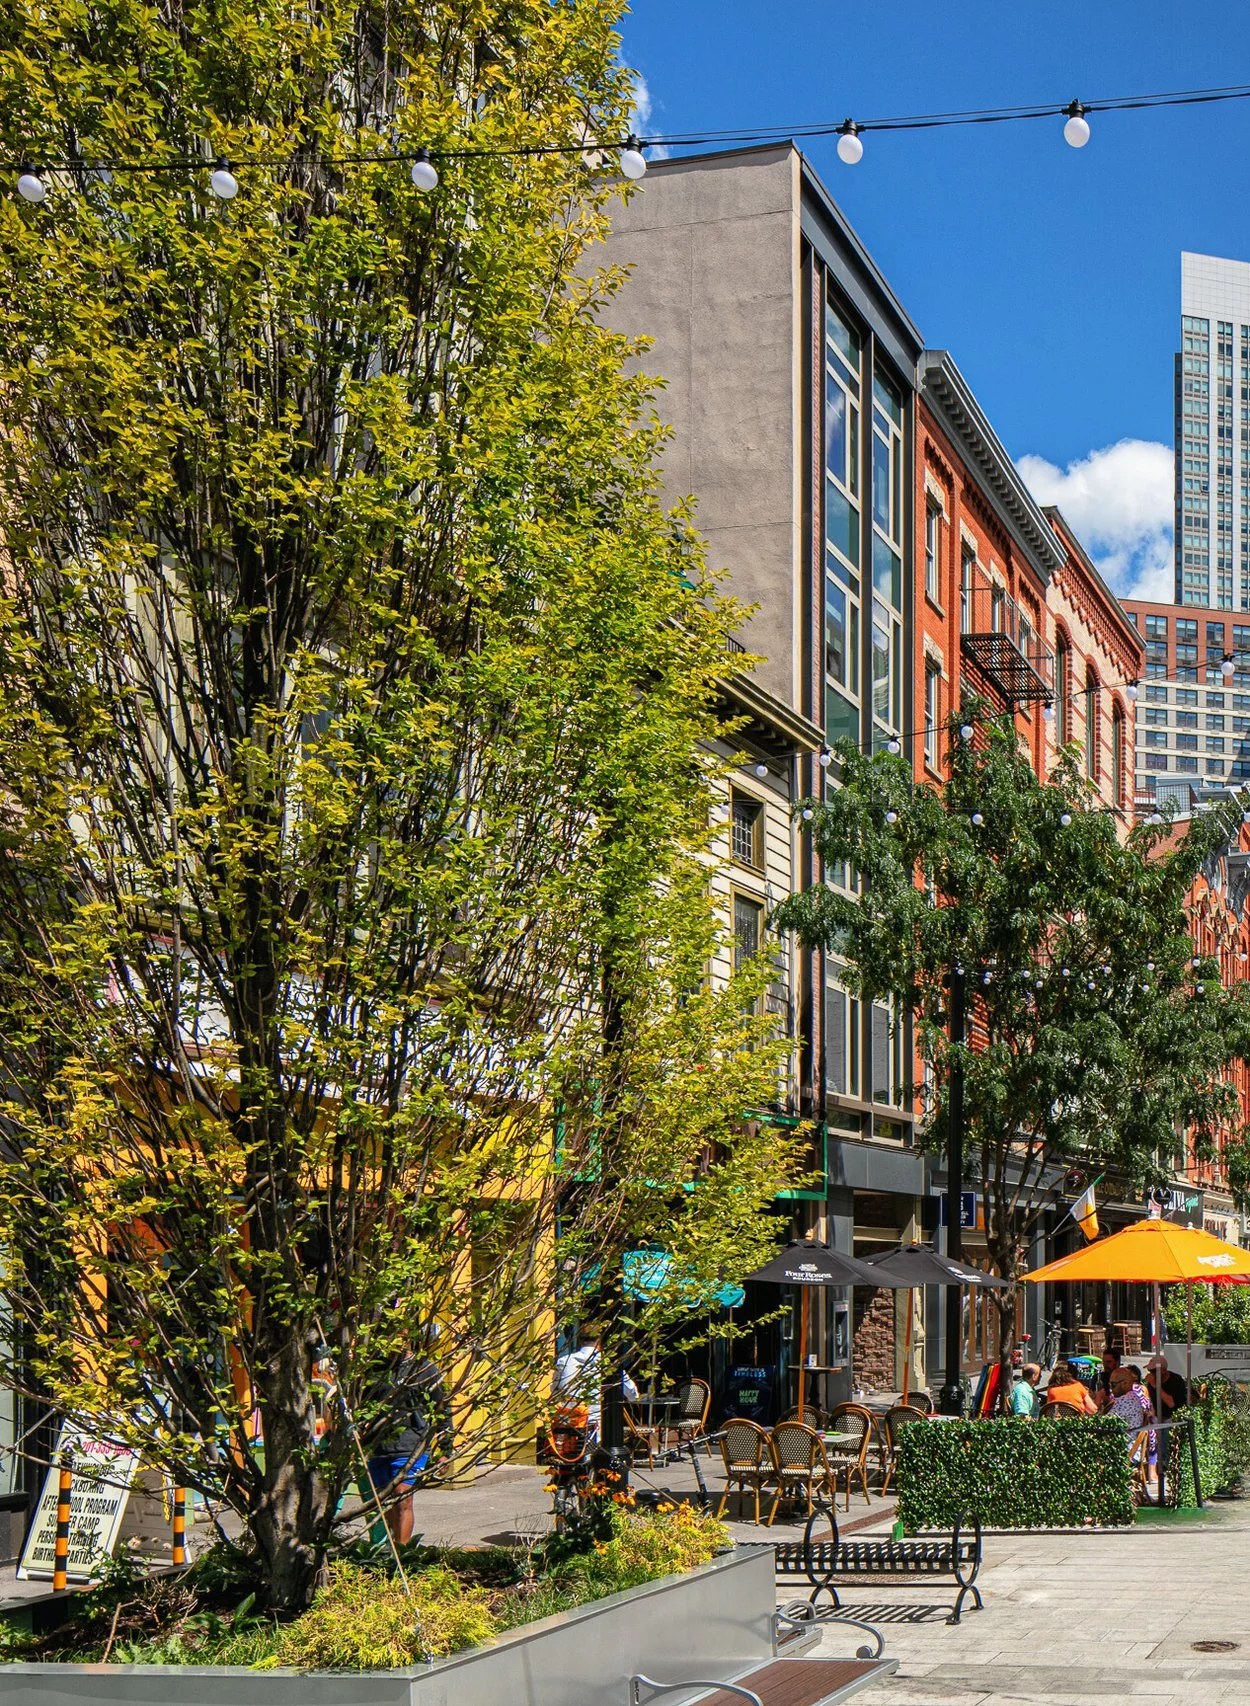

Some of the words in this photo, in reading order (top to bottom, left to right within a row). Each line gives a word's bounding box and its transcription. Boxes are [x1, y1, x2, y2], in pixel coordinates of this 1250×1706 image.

[71, 1478, 105, 1494] CKBOXING
[83, 1498, 118, 1515] PROGRAM
[46, 1513, 77, 1529] SUER
[78, 1516, 100, 1530] CAMP
[67, 1549, 93, 1565] PARTIES
